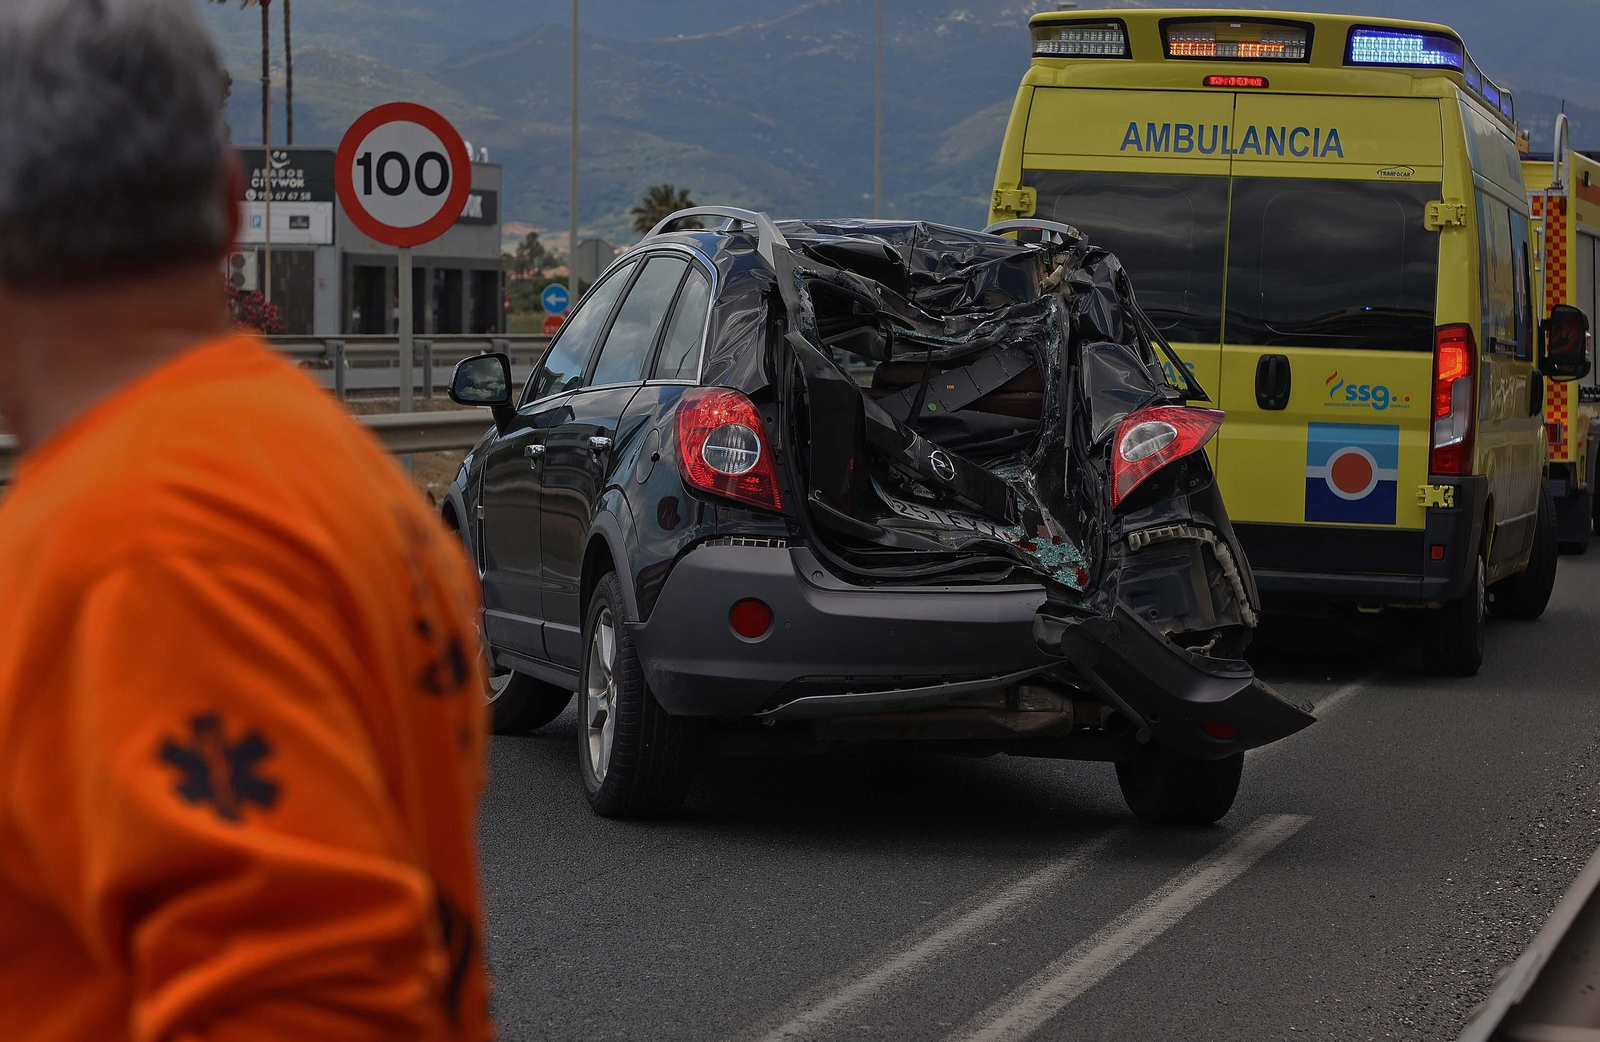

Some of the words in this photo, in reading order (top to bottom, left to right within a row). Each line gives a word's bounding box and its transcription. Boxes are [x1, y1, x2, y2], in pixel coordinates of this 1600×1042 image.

[1120, 121, 1345, 159] AMBULANCIA
[251, 177, 306, 188] CIYWOK
[356, 151, 450, 197] 100
[1345, 384, 1390, 411] ssg
